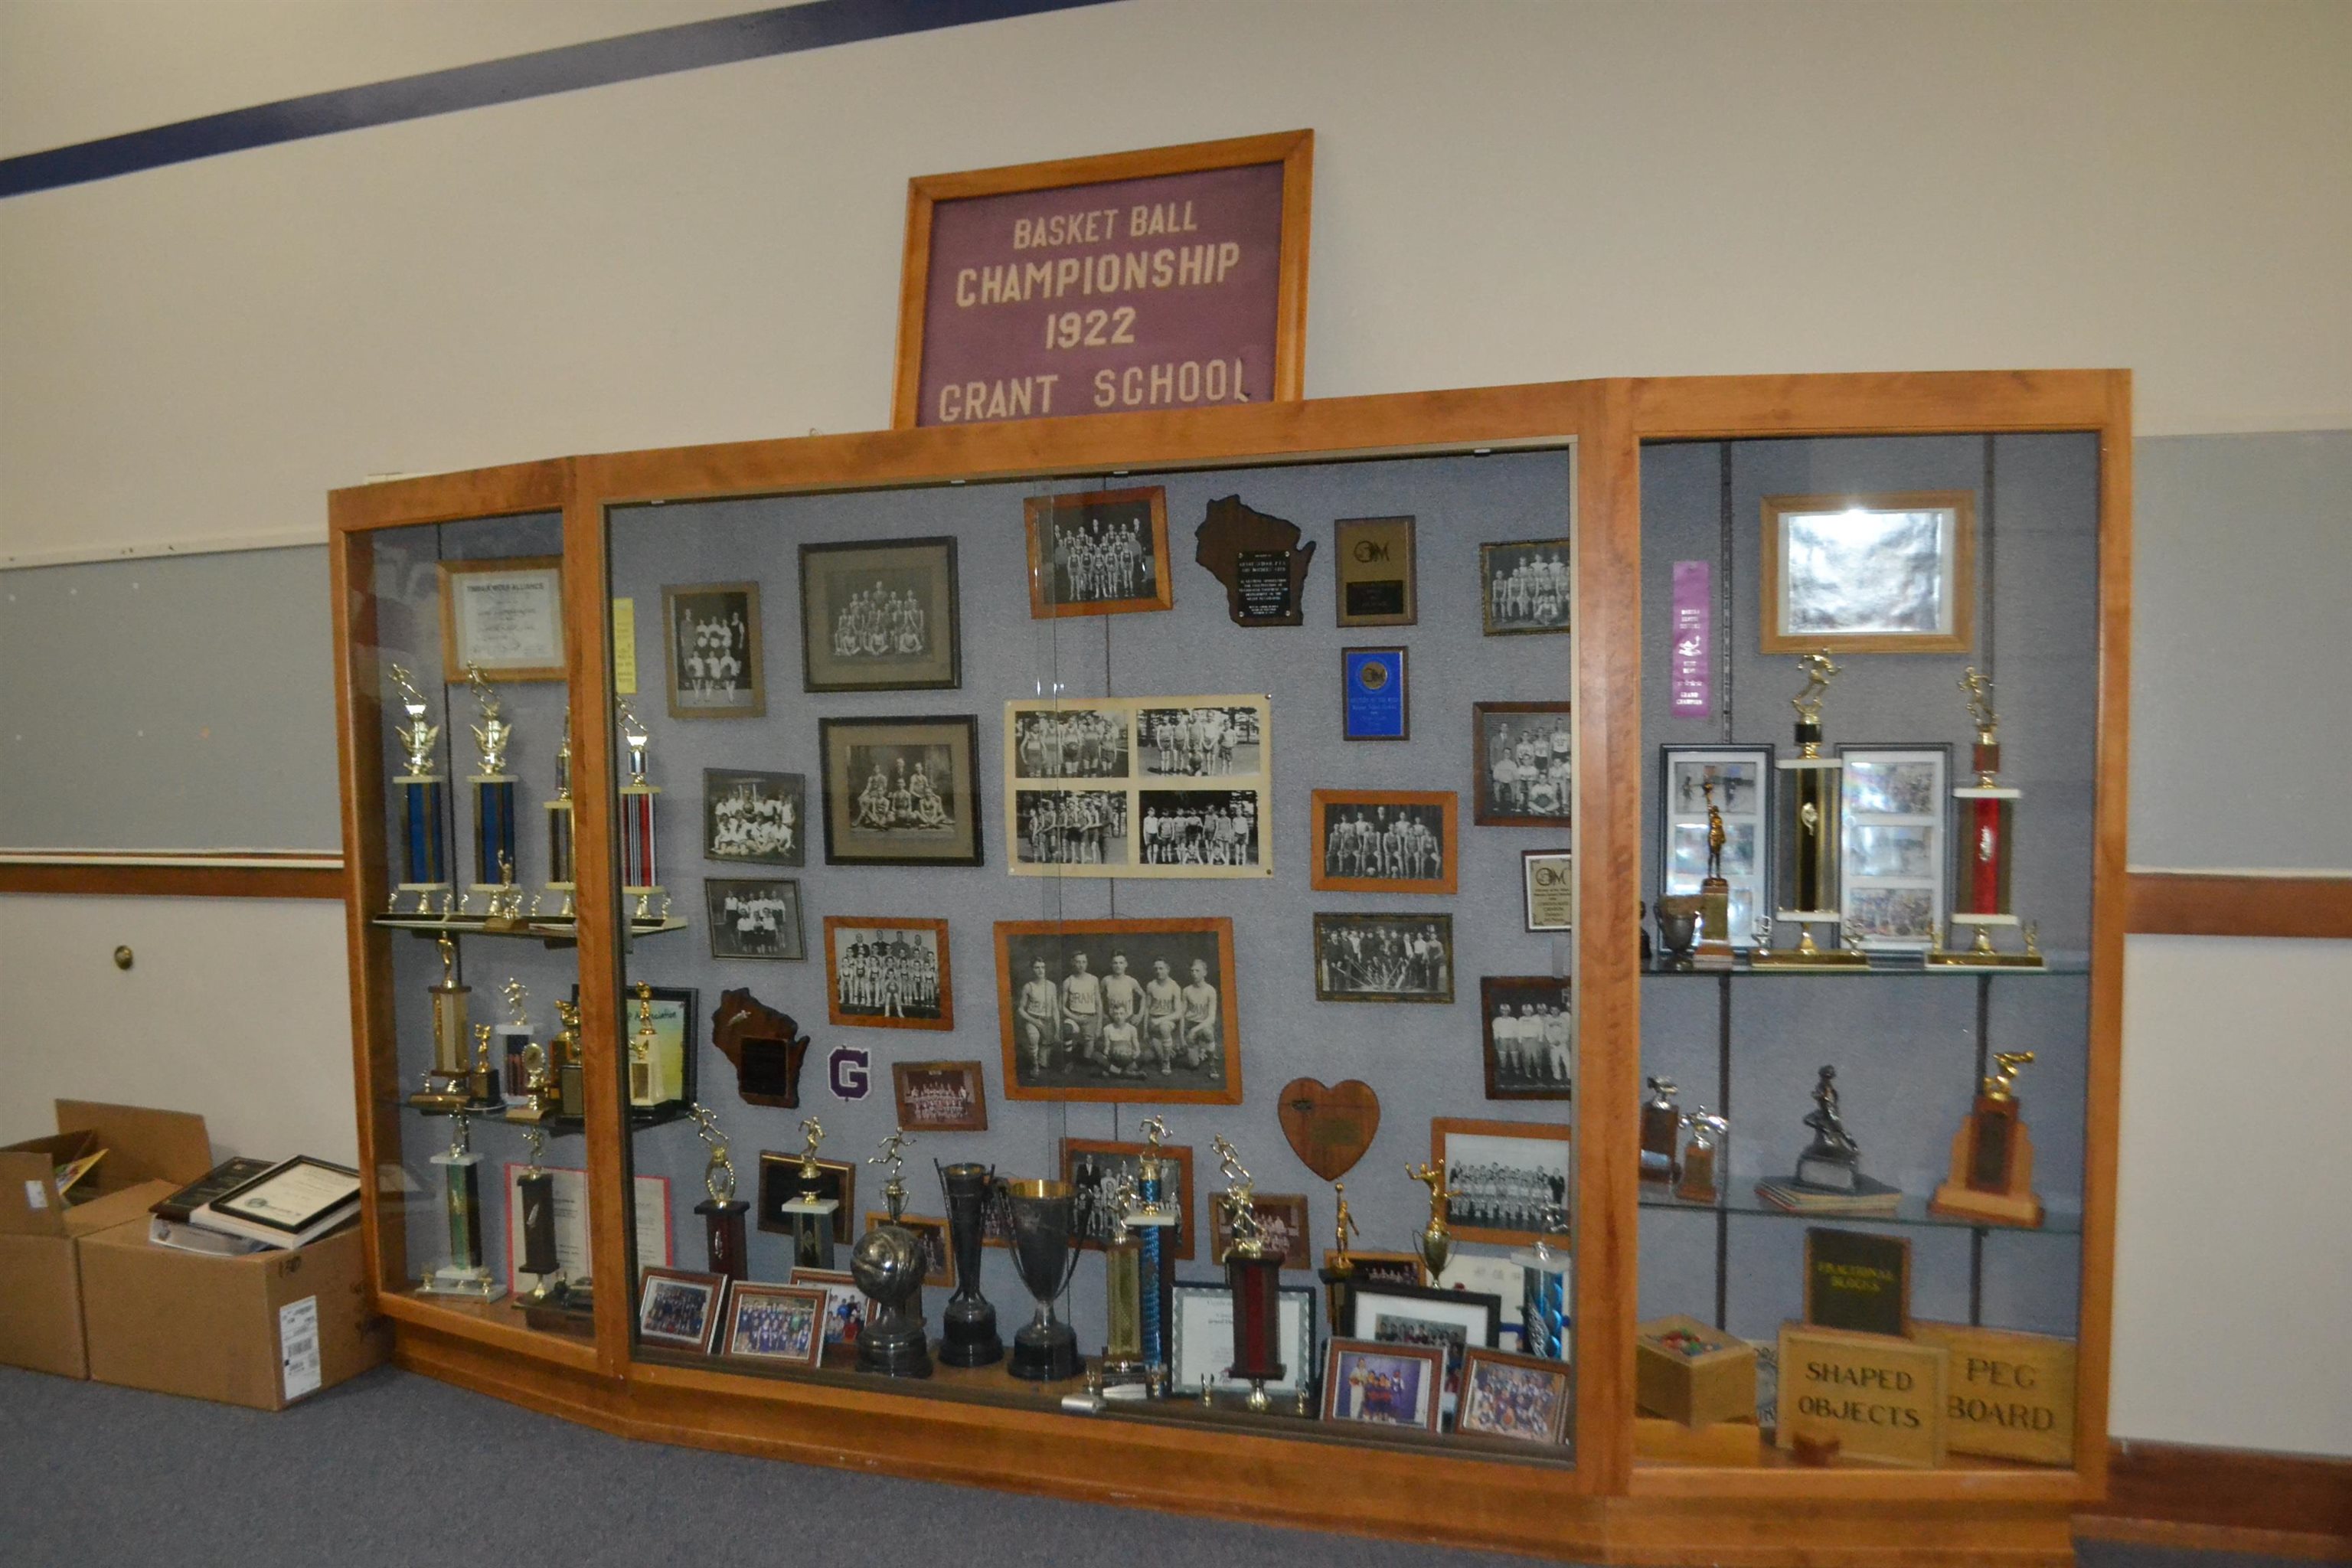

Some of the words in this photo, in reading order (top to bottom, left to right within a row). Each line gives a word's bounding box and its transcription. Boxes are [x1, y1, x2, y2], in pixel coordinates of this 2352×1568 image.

[1013, 209, 1119, 250] BASKET
[1130, 201, 1197, 237] BALL
[956, 242, 1240, 307] CHAMPIONSHIP
[1045, 307, 1136, 349] 1922
[939, 374, 1059, 423] GRANT
[1094, 358, 1250, 408] SCHOOL
[828, 1047, 871, 1101] G
[1805, 1361, 1913, 1392] SHAPED
[1966, 1357, 2037, 1388] PEG
[1798, 1396, 1920, 1429] OBJECTS
[1947, 1396, 2055, 1432] BOARD
